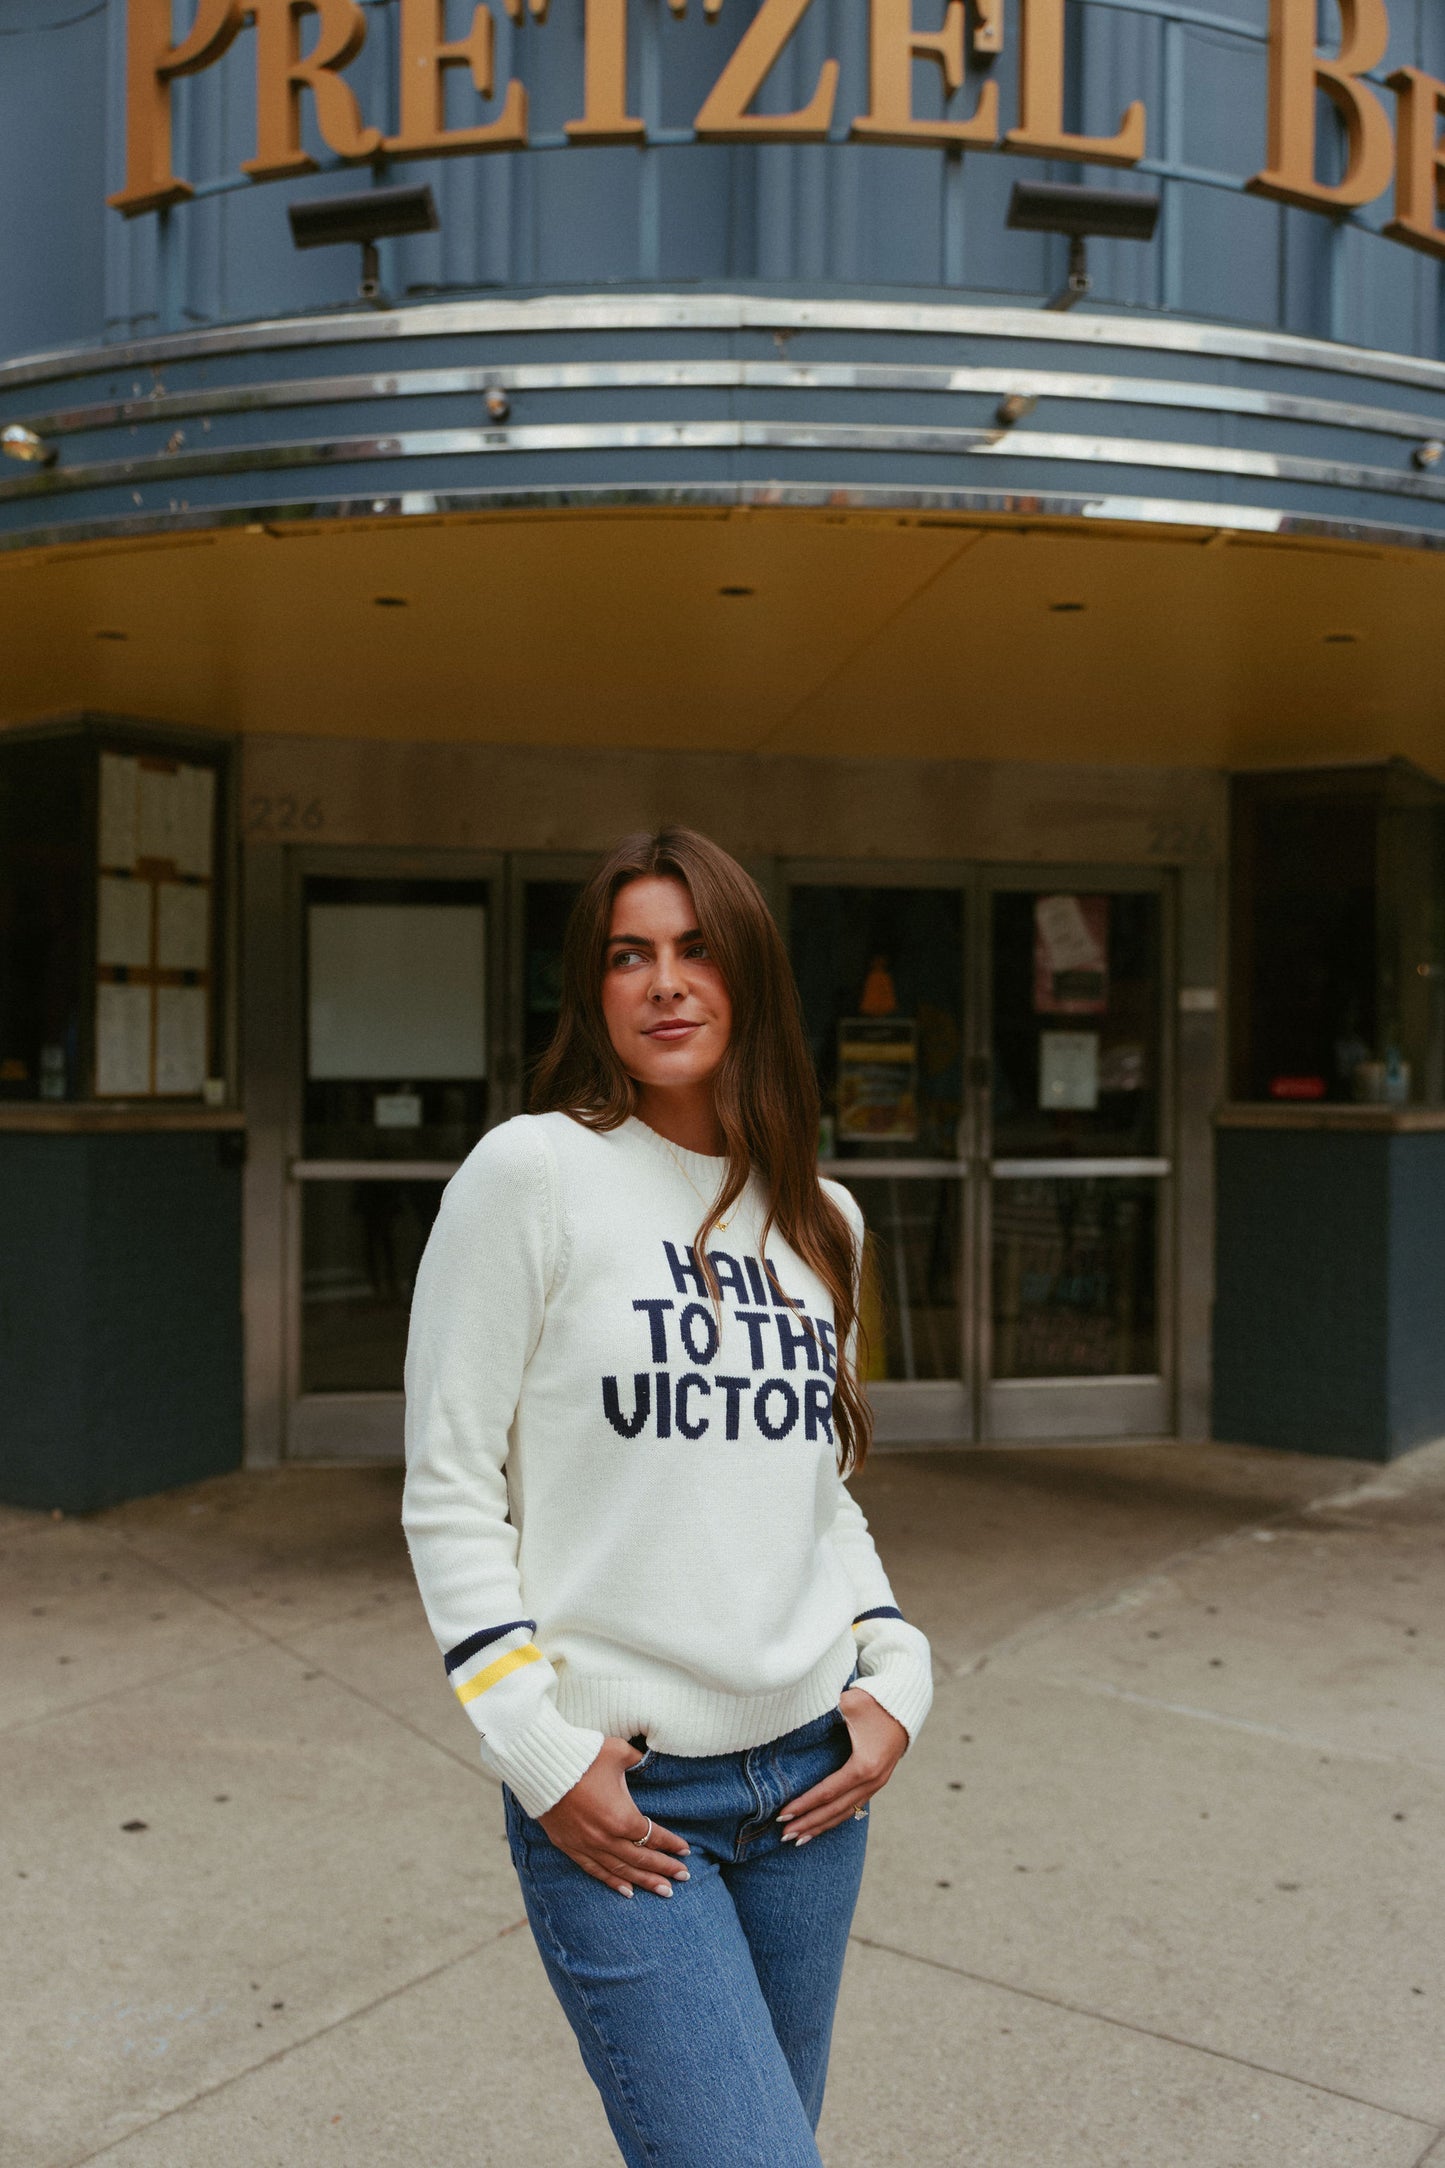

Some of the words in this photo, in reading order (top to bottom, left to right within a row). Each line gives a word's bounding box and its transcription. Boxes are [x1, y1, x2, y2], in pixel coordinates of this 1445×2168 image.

[106, 0, 1146, 220] PRETZEL
[251, 796, 325, 832] 226
[662, 1240, 805, 1308] HAIL
[632, 1299, 719, 1365] TO
[734, 1311, 836, 1382] THE
